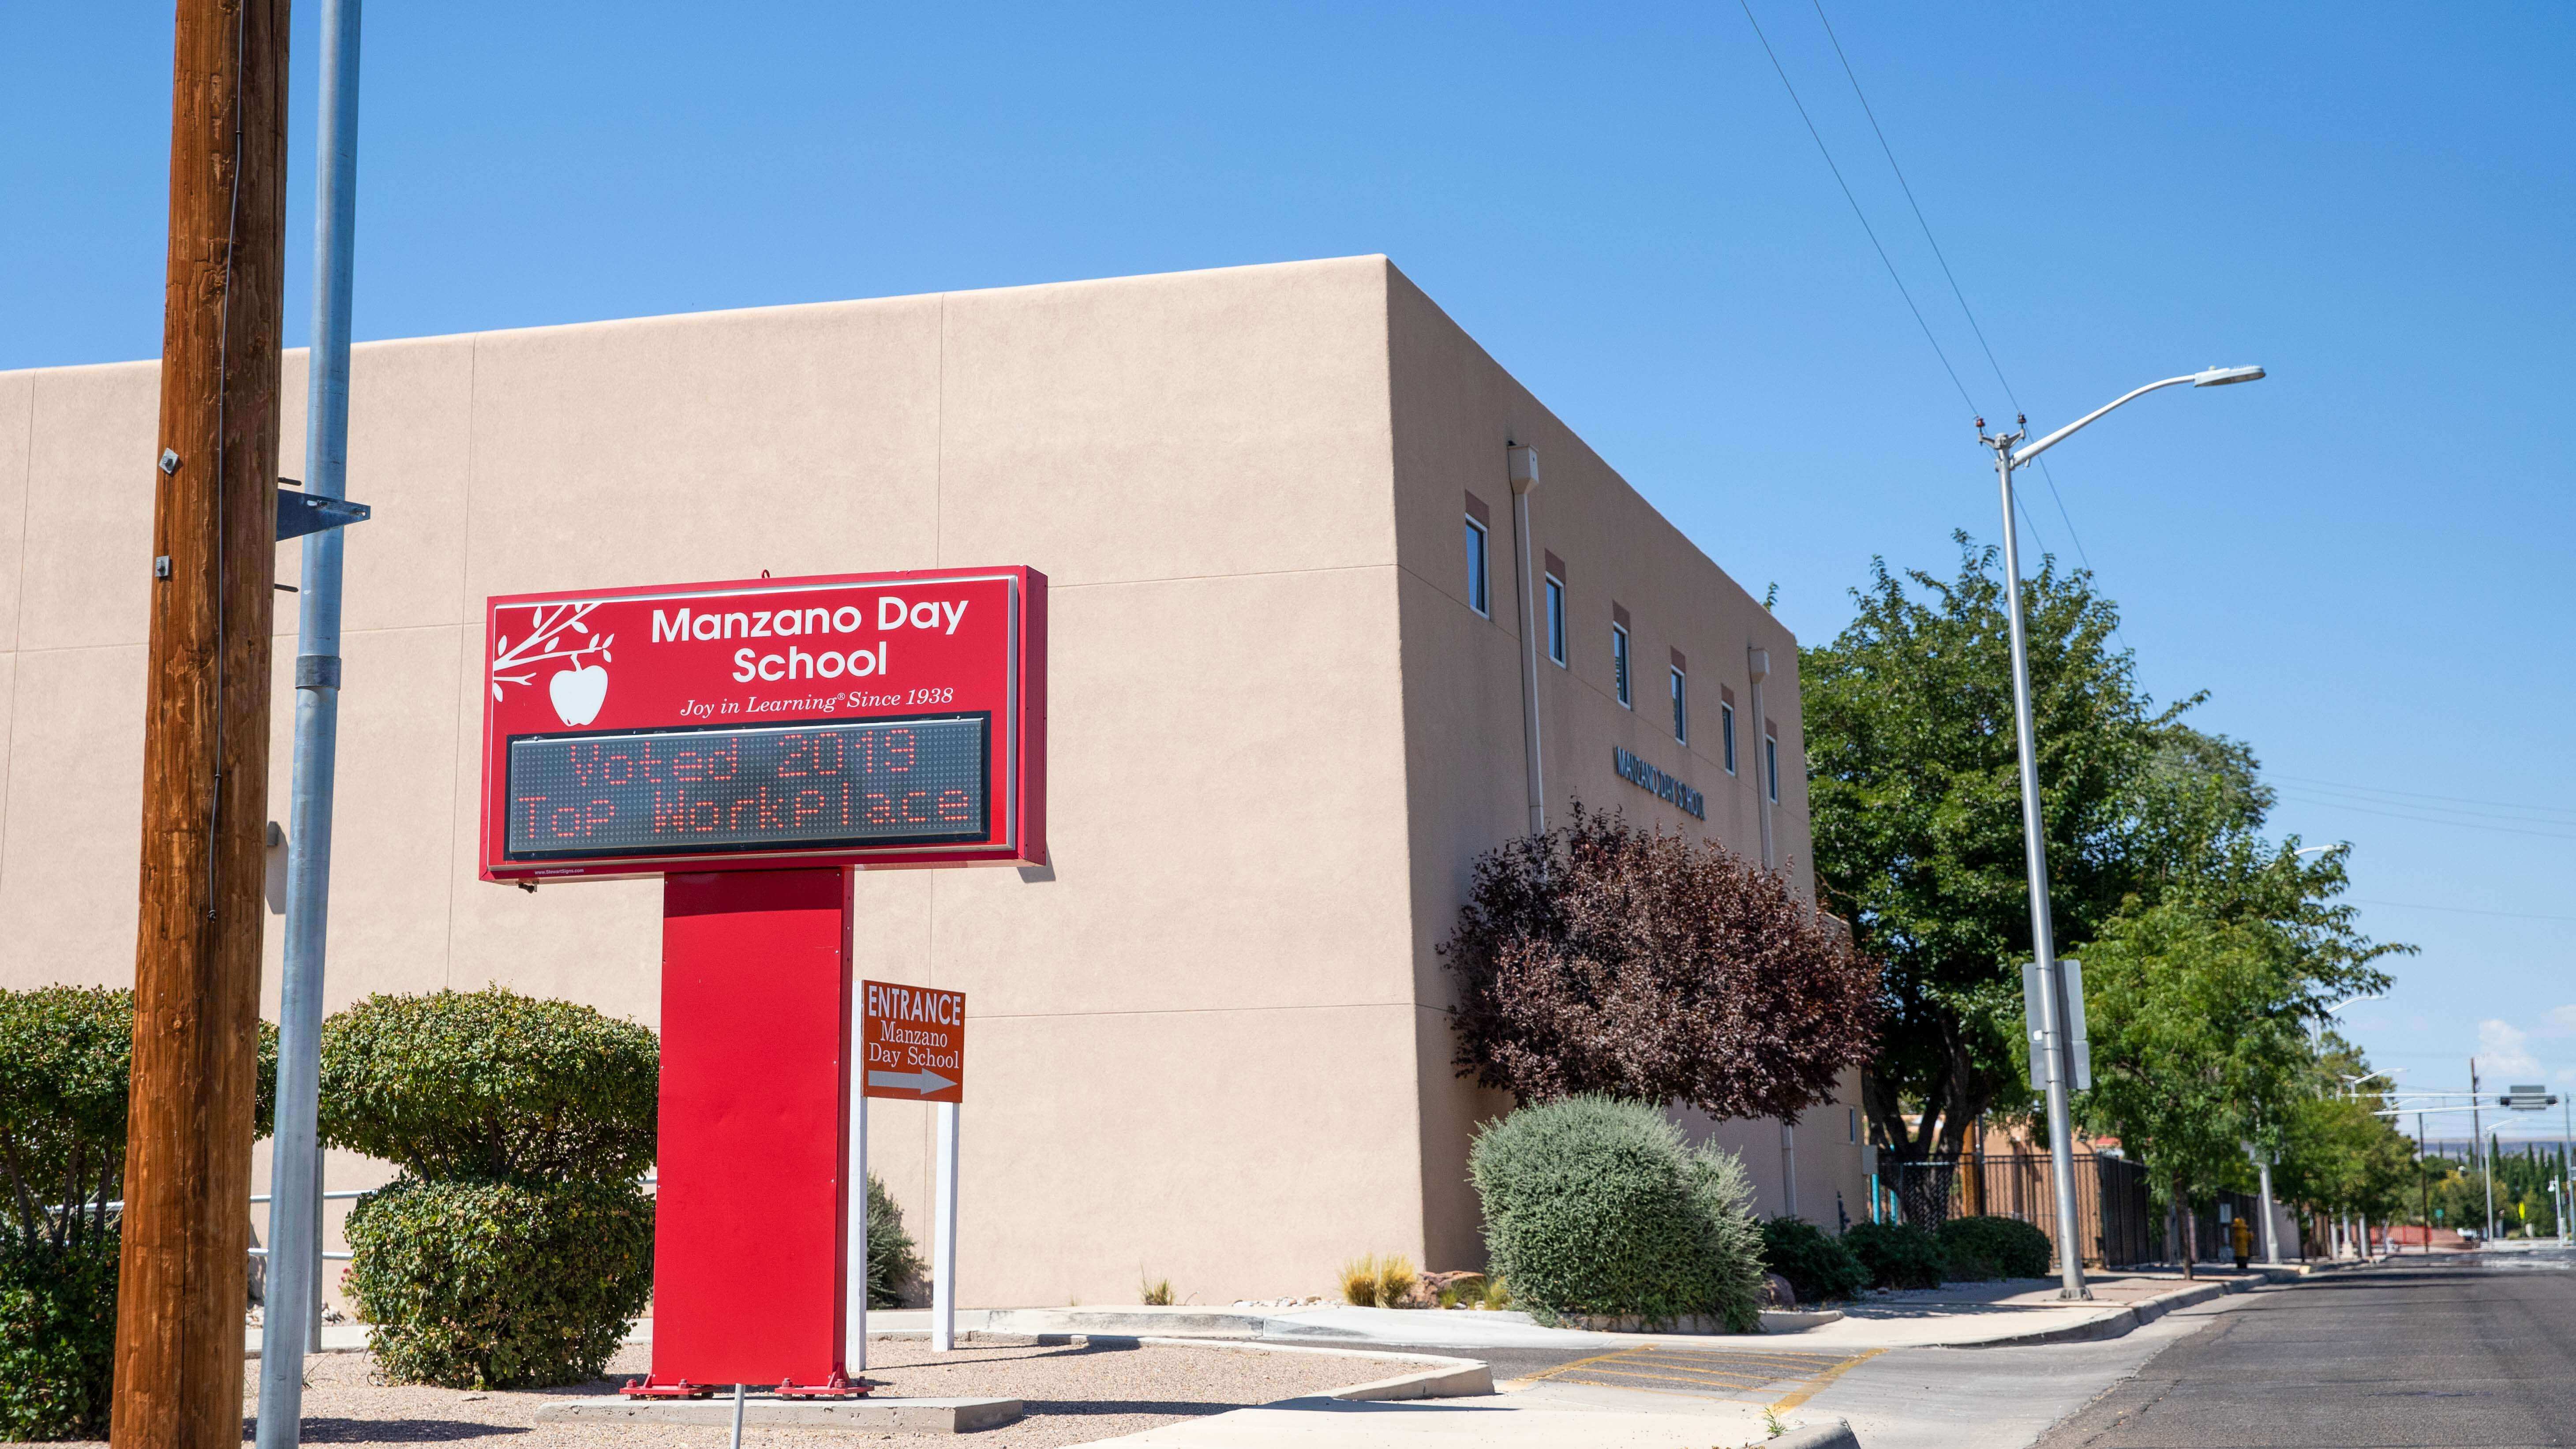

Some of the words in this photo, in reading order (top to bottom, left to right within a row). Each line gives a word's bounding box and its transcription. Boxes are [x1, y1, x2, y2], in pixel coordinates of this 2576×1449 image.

[652, 606, 862, 643] Manzano
[878, 596, 969, 635] Day
[732, 641, 887, 683] School
[680, 700, 715, 719] Joy
[721, 698, 740, 714] in
[846, 691, 901, 708] Since
[906, 687, 954, 704] 1938
[570, 737, 738, 787] Voted
[778, 729, 915, 778] 2019
[868, 985, 961, 1026] ENTRANCE
[880, 1020, 948, 1048] Manzano
[869, 1042, 901, 1068] Day
[907, 1046, 959, 1069] School
